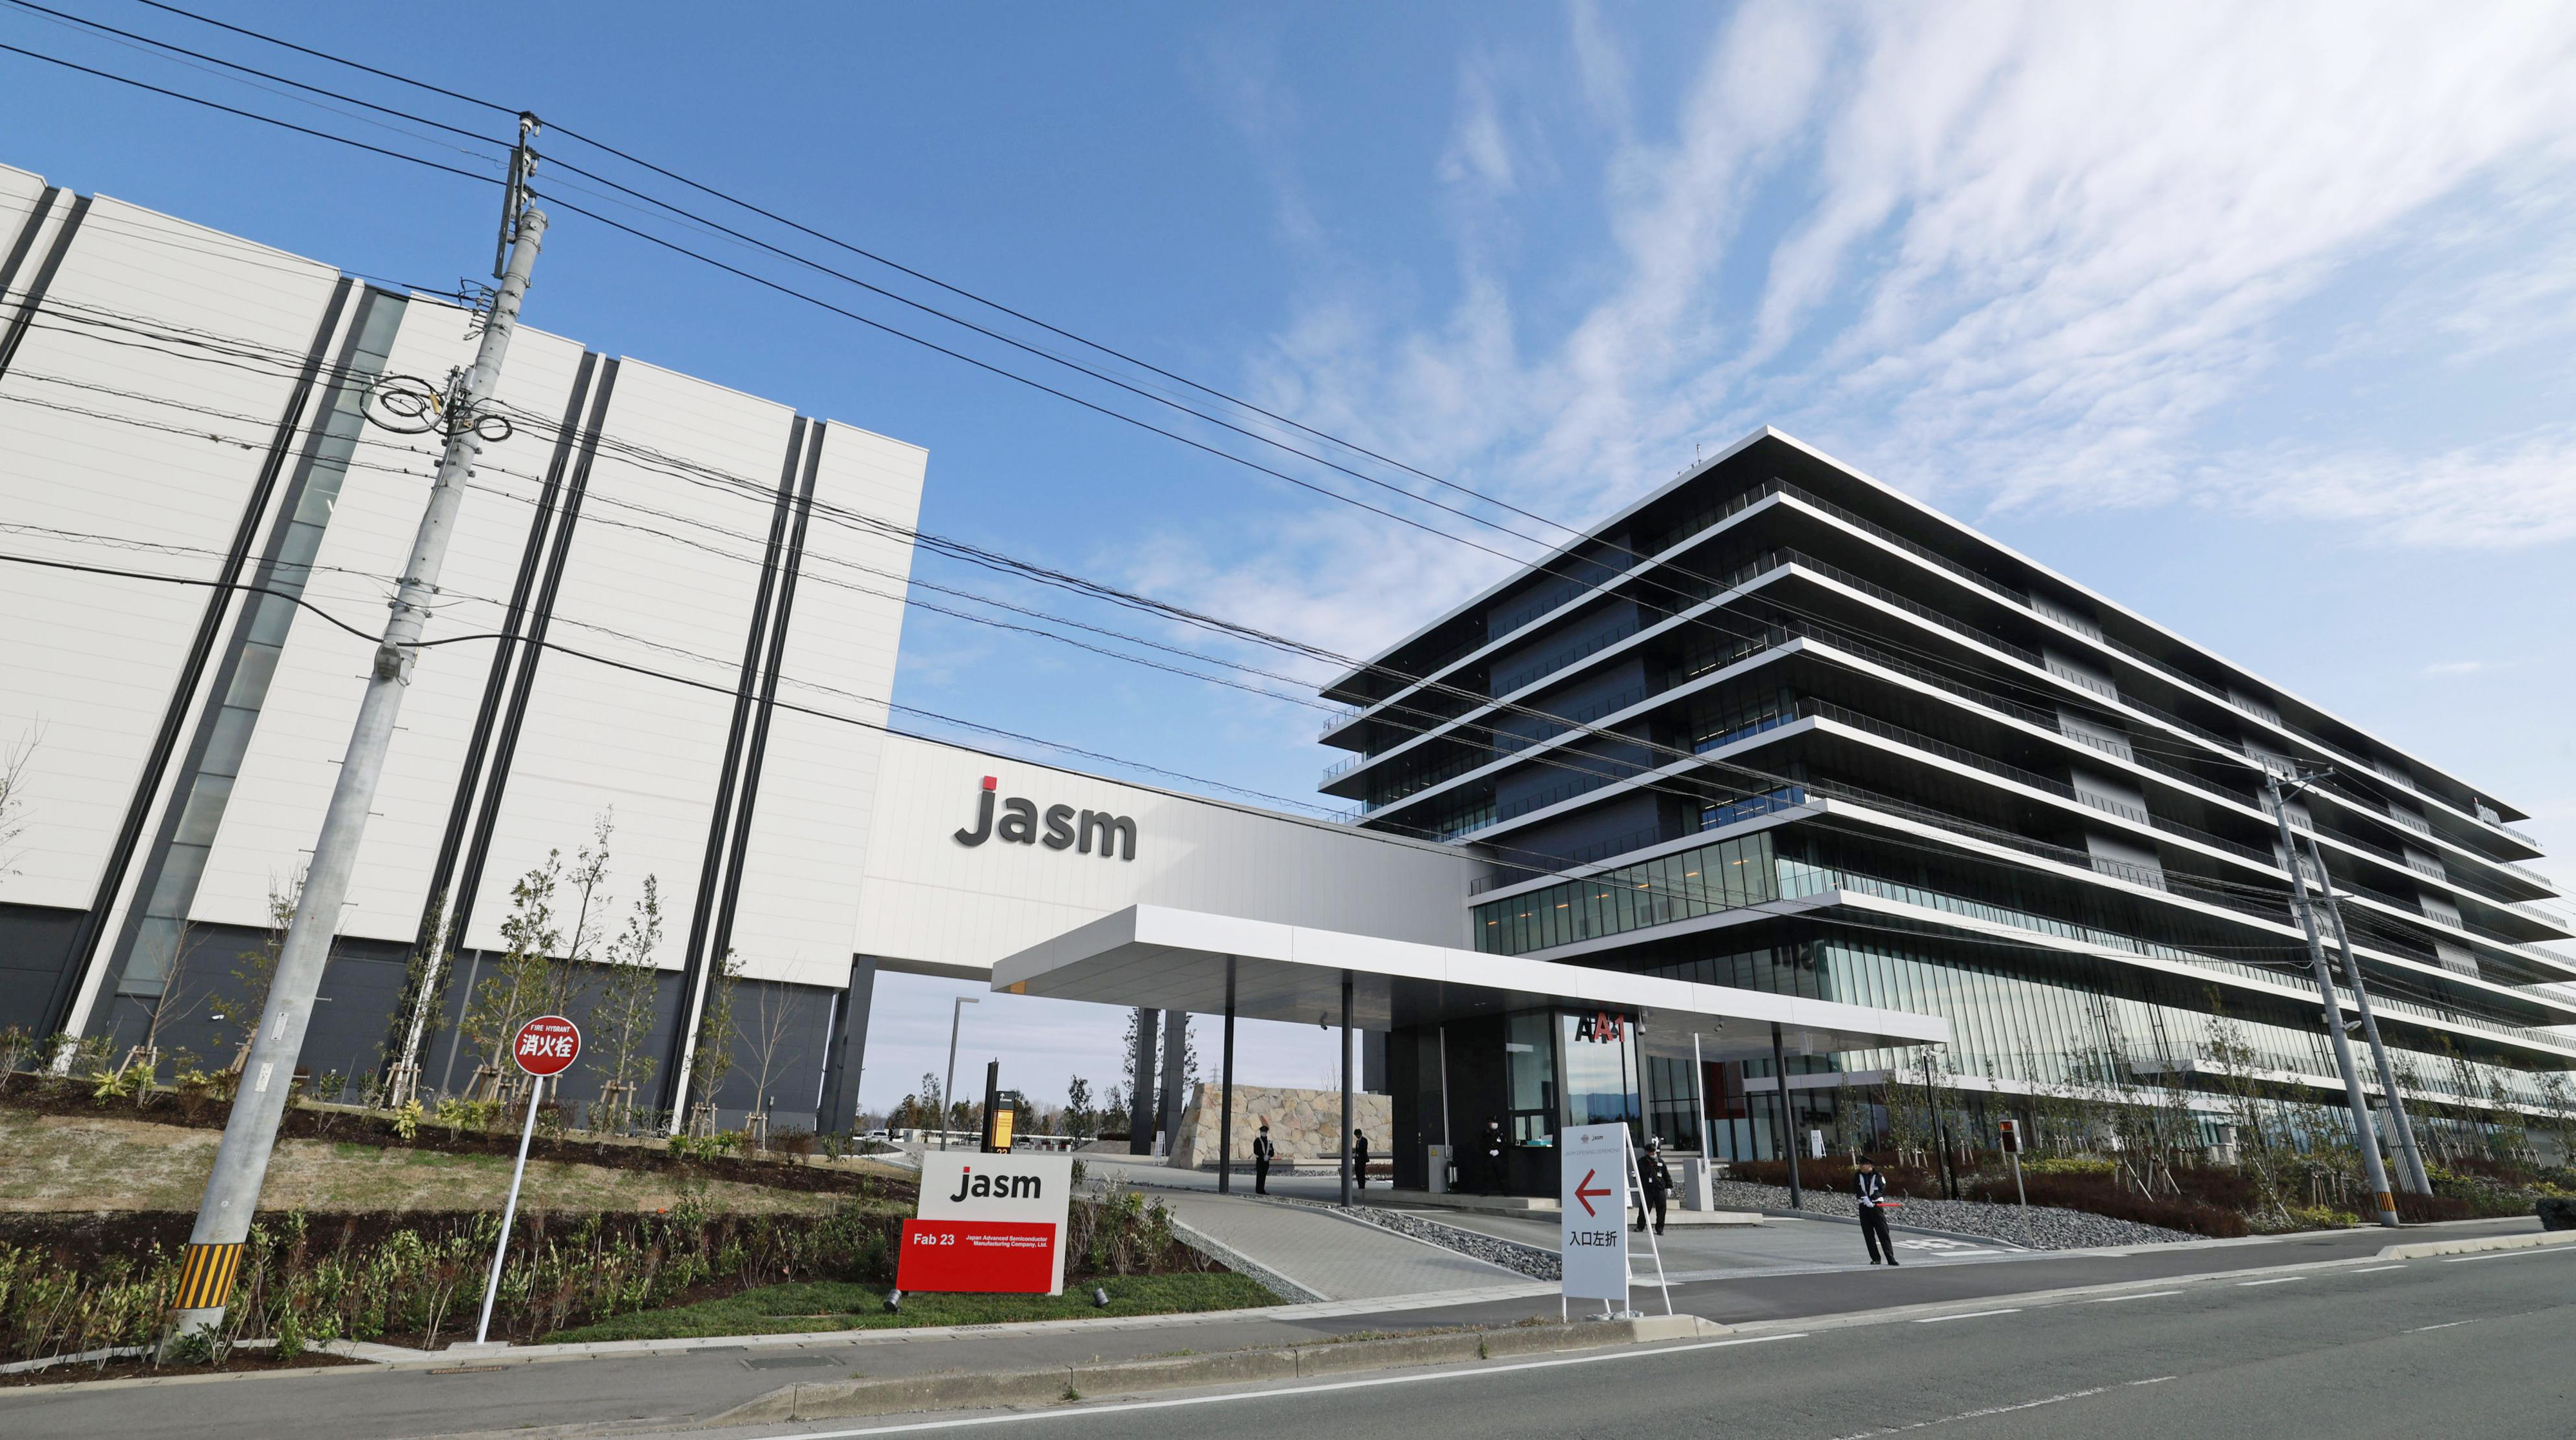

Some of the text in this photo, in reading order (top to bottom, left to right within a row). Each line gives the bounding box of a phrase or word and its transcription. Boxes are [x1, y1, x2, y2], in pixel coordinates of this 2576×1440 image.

[954, 775, 1137, 860] jasm
[519, 1034, 574, 1057] 消火栓
[950, 1166, 1041, 1202] jasm
[913, 1233, 954, 1246] Fab 23
[1569, 1231, 1617, 1247] 入口左折
